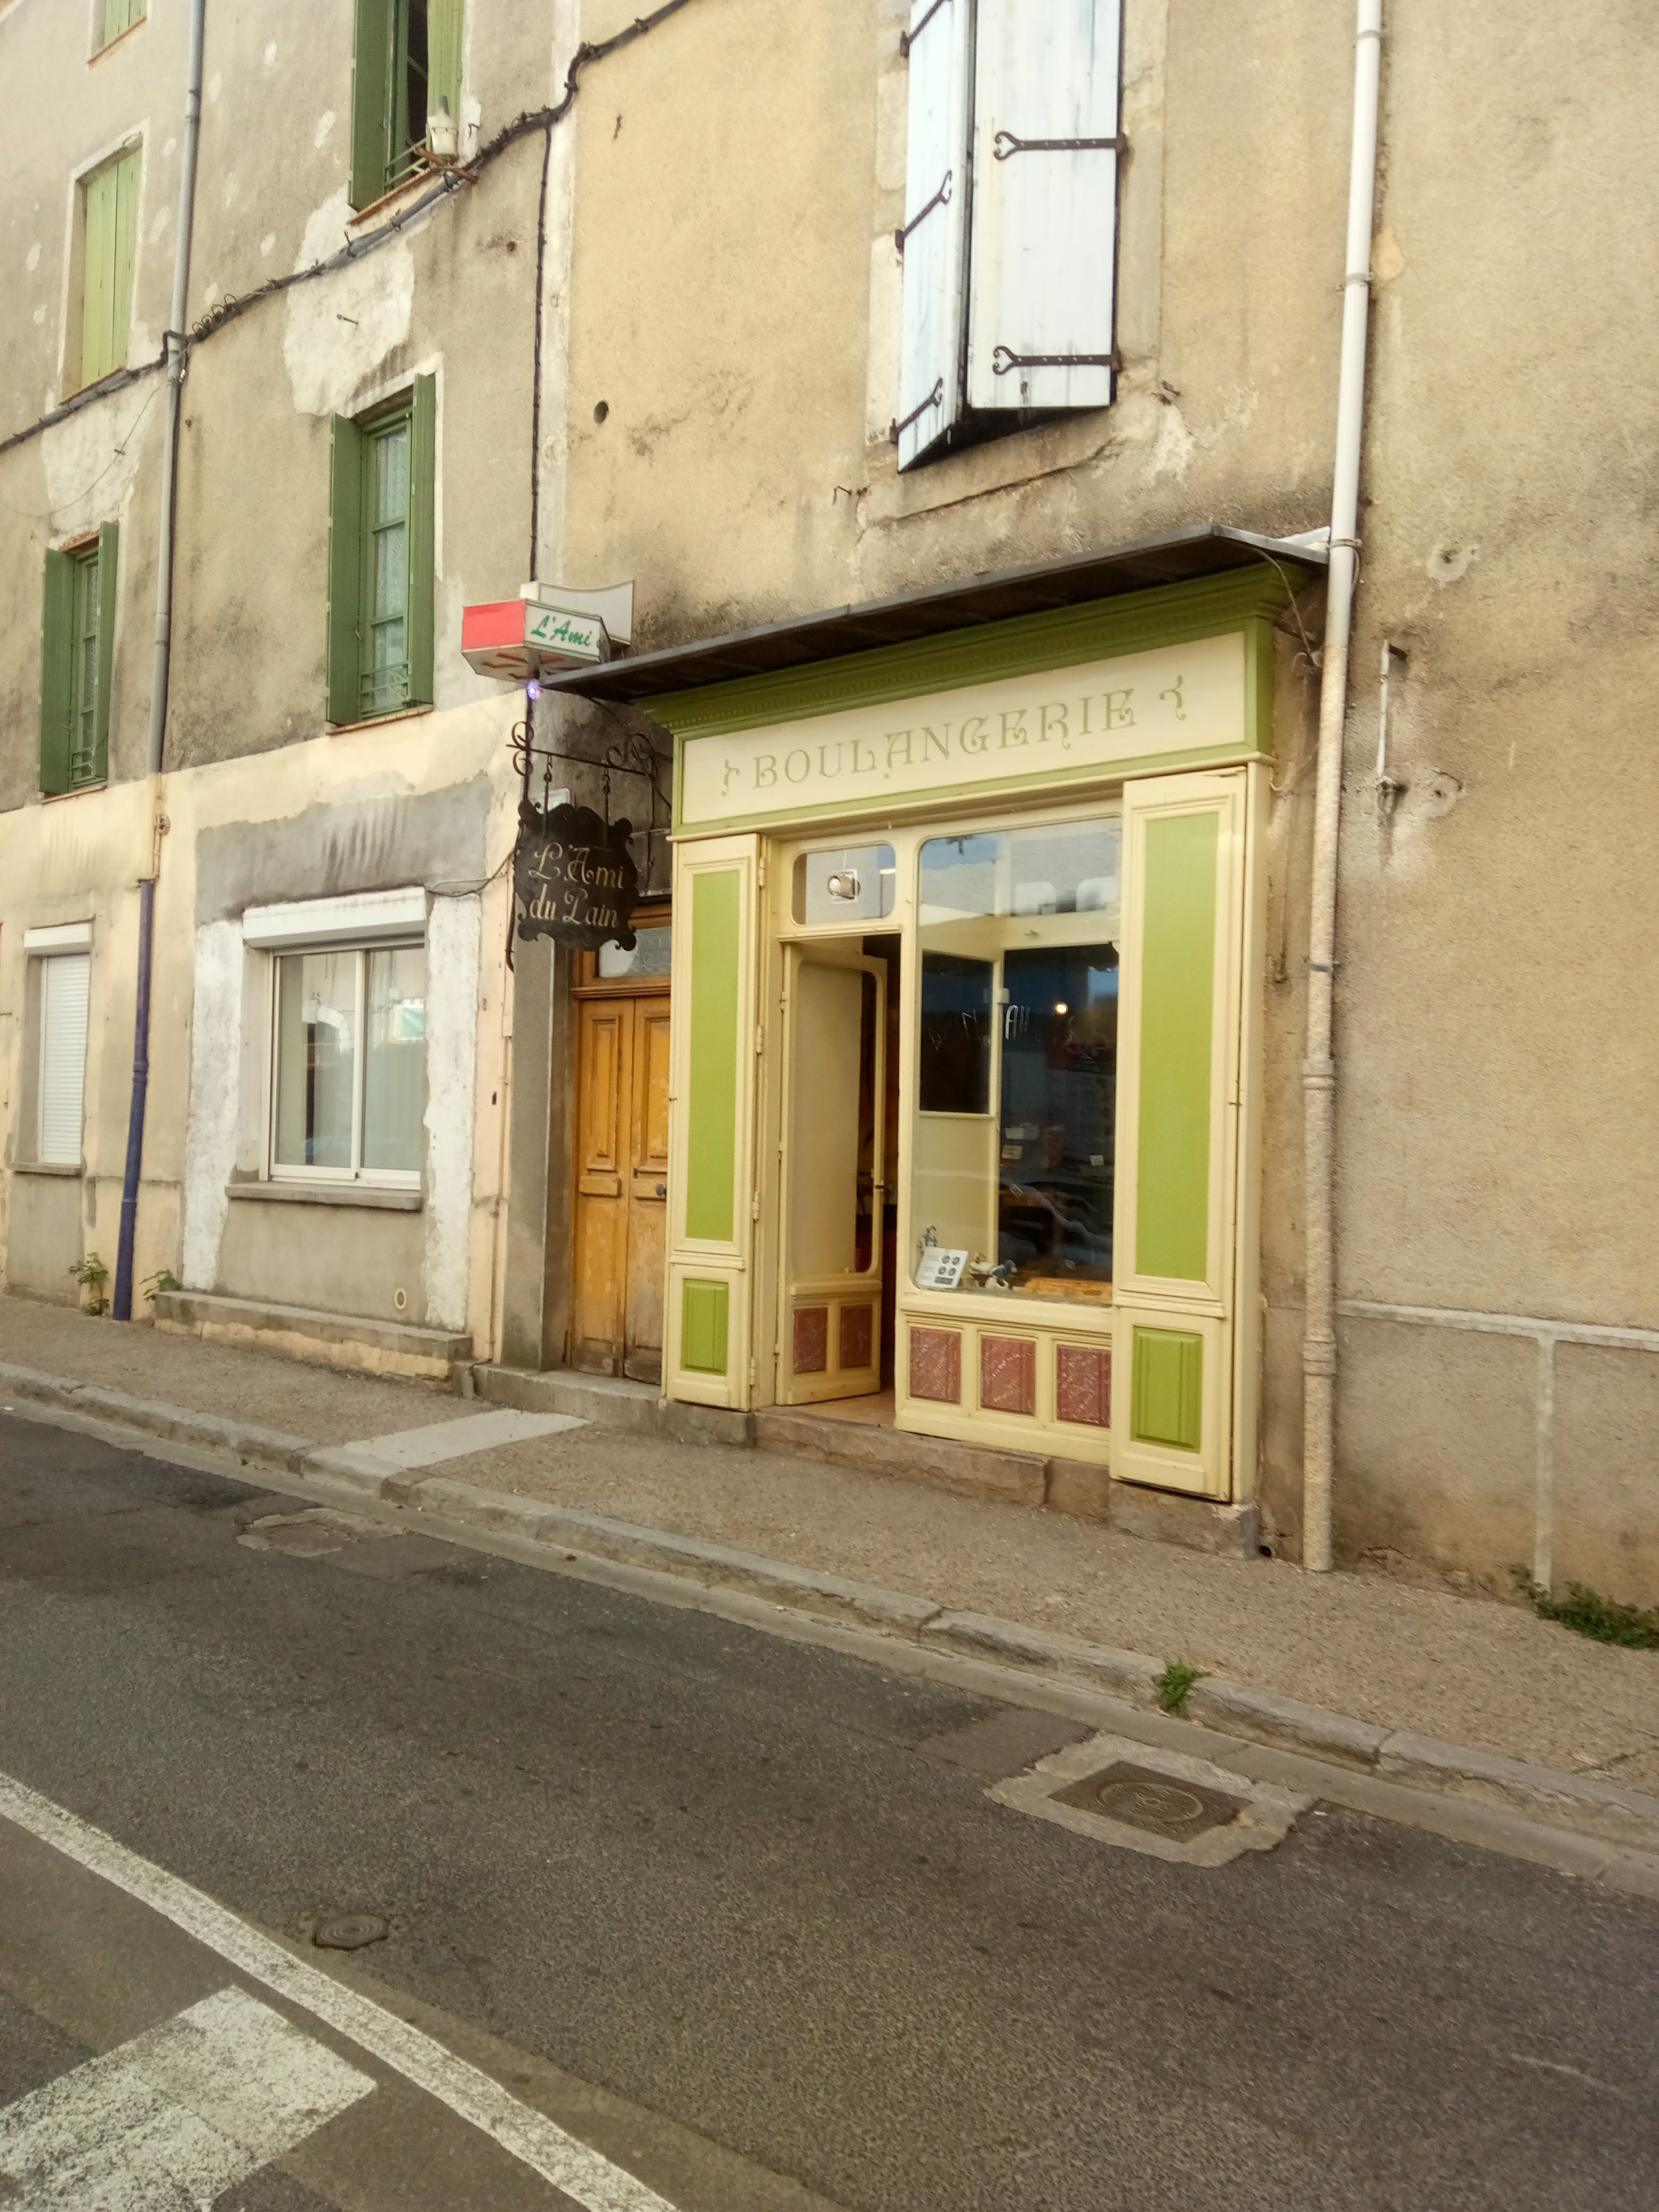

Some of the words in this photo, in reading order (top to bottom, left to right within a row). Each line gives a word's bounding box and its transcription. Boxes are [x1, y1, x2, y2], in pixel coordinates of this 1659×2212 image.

[531, 614, 592, 647] L'Ami
[752, 688, 1137, 789] BOULANGERIE
[529, 883, 557, 920] du
[562, 887, 618, 928] Pain
